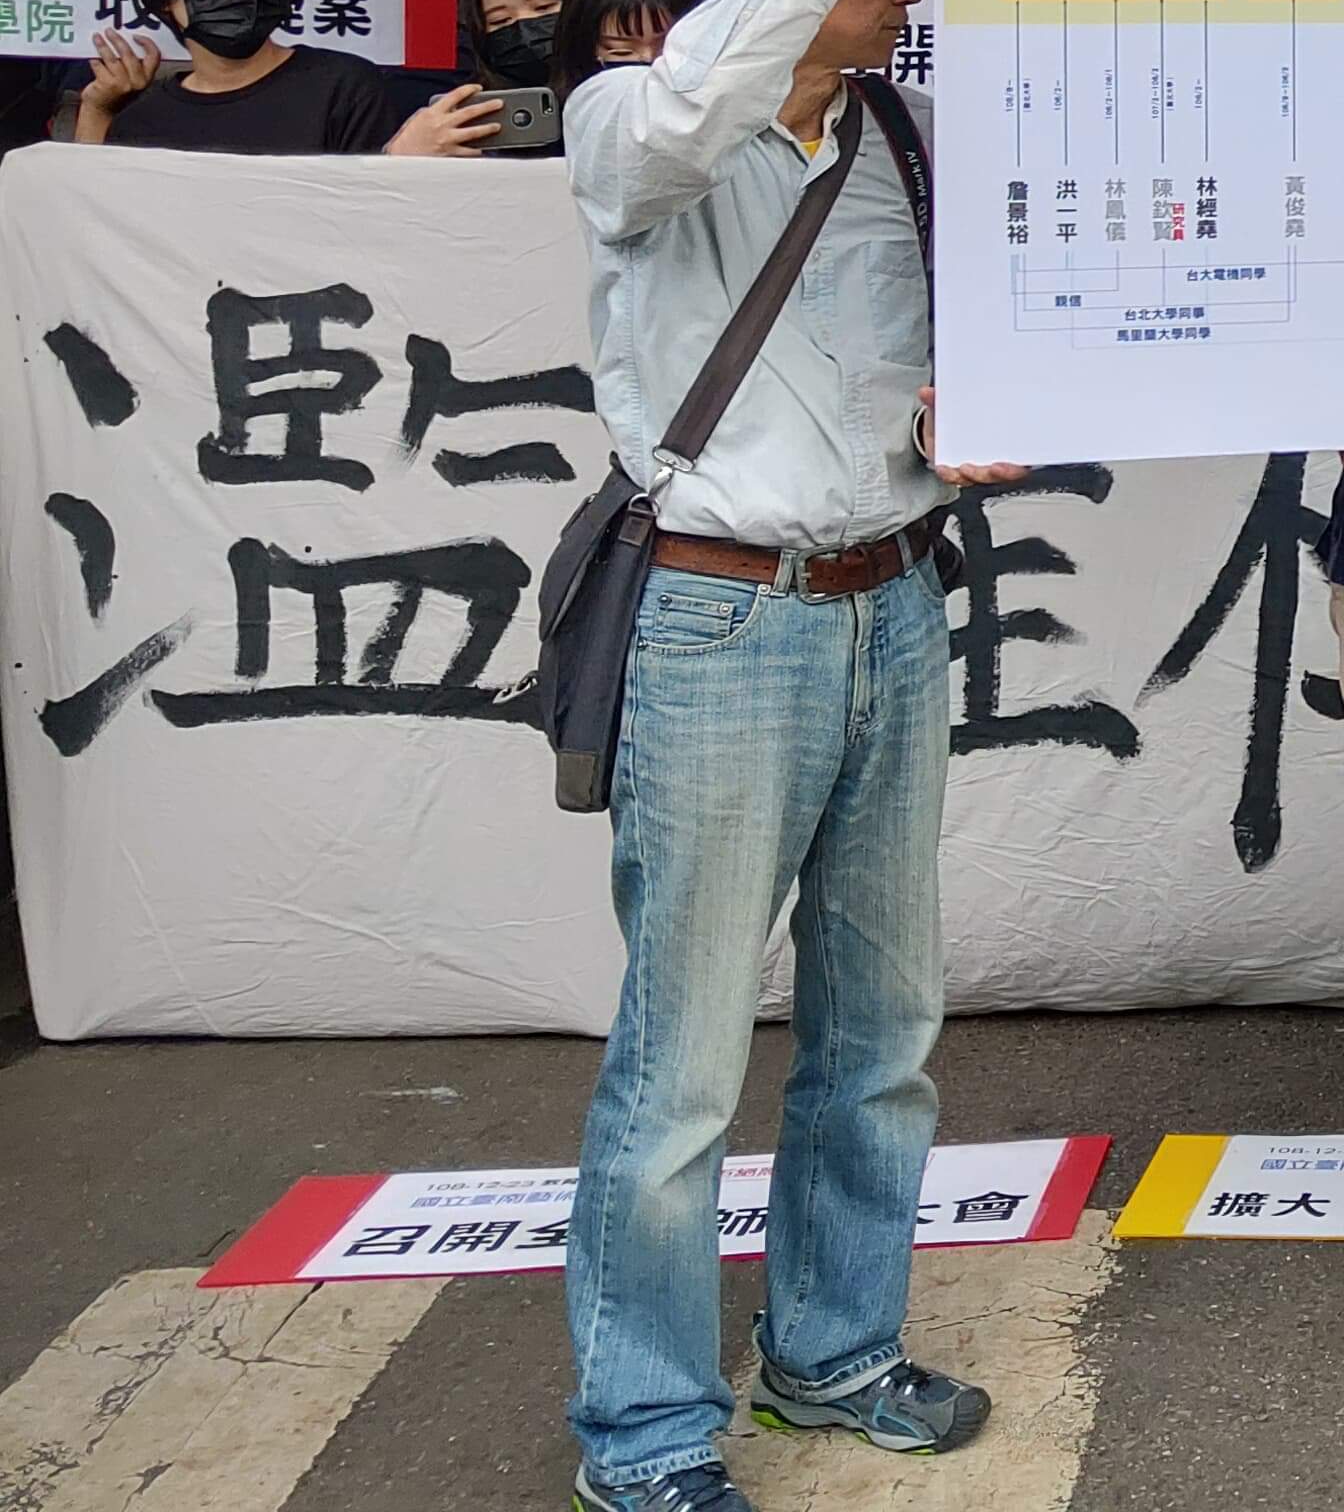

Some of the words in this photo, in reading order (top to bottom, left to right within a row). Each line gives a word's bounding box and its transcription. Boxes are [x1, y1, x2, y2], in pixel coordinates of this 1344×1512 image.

[1007, 180, 1029, 244] 詹景裕
[1055, 179, 1078, 243] 洪一平
[1105, 178, 1126, 241] 林鳳儀
[1172, 202, 1185, 241] 研究員
[1186, 266, 1266, 282] 台大電機同學
[1206, 1191, 1332, 1220] 擴大
